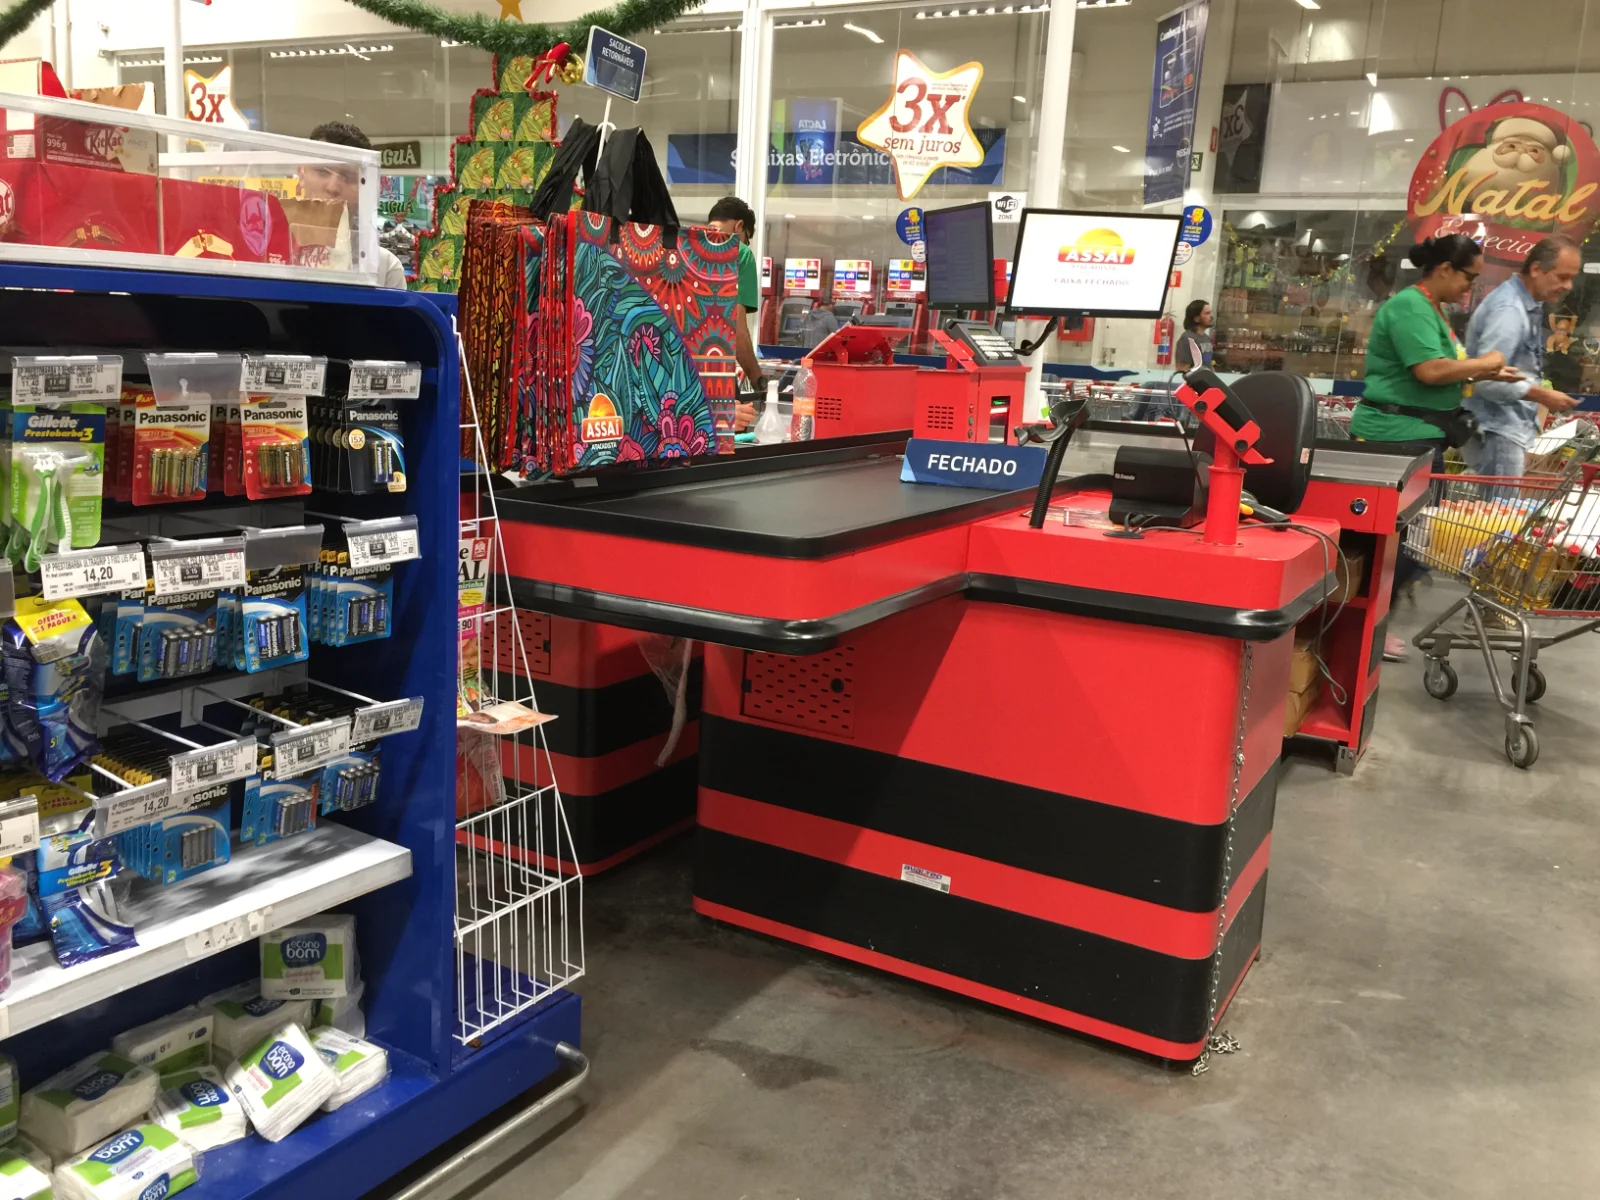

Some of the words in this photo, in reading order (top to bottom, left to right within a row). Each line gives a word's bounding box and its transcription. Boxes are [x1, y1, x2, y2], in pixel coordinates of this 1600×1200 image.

[609, 38, 631, 55] SACOLAS
[602, 47, 634, 68] RETORNÁVEIS
[883, 137, 914, 151] sem
[917, 135, 961, 155] juros
[380, 145, 417, 165] GUÁ
[1413, 167, 1599, 223] Natal
[27, 414, 79, 428] Gillette
[139, 410, 207, 424] Panasonic
[244, 408, 303, 421] Panasonic
[350, 410, 399, 421] Panasonic
[586, 420, 620, 438] ASSAÍ
[350, 435, 364, 444] 15X
[927, 453, 1018, 476] FECHADO
[83, 566, 114, 583] 14,20
[340, 564, 391, 578] Panasonic
[245, 578, 302, 597] Panasonic
[148, 589, 215, 606] Panasonic
[37, 612, 64, 625] OFERTA
[47, 616, 71, 630] PAGUE
[194, 786, 228, 803] sonic
[143, 796, 170, 813] 14,20
[96, 859, 114, 878] 3
[286, 943, 320, 959] bom
[291, 940, 320, 949] econo
[266, 1045, 288, 1078] bom
[278, 1045, 296, 1069] econo
[95, 1134, 140, 1159] bom
[145, 1179, 166, 1195] econo
